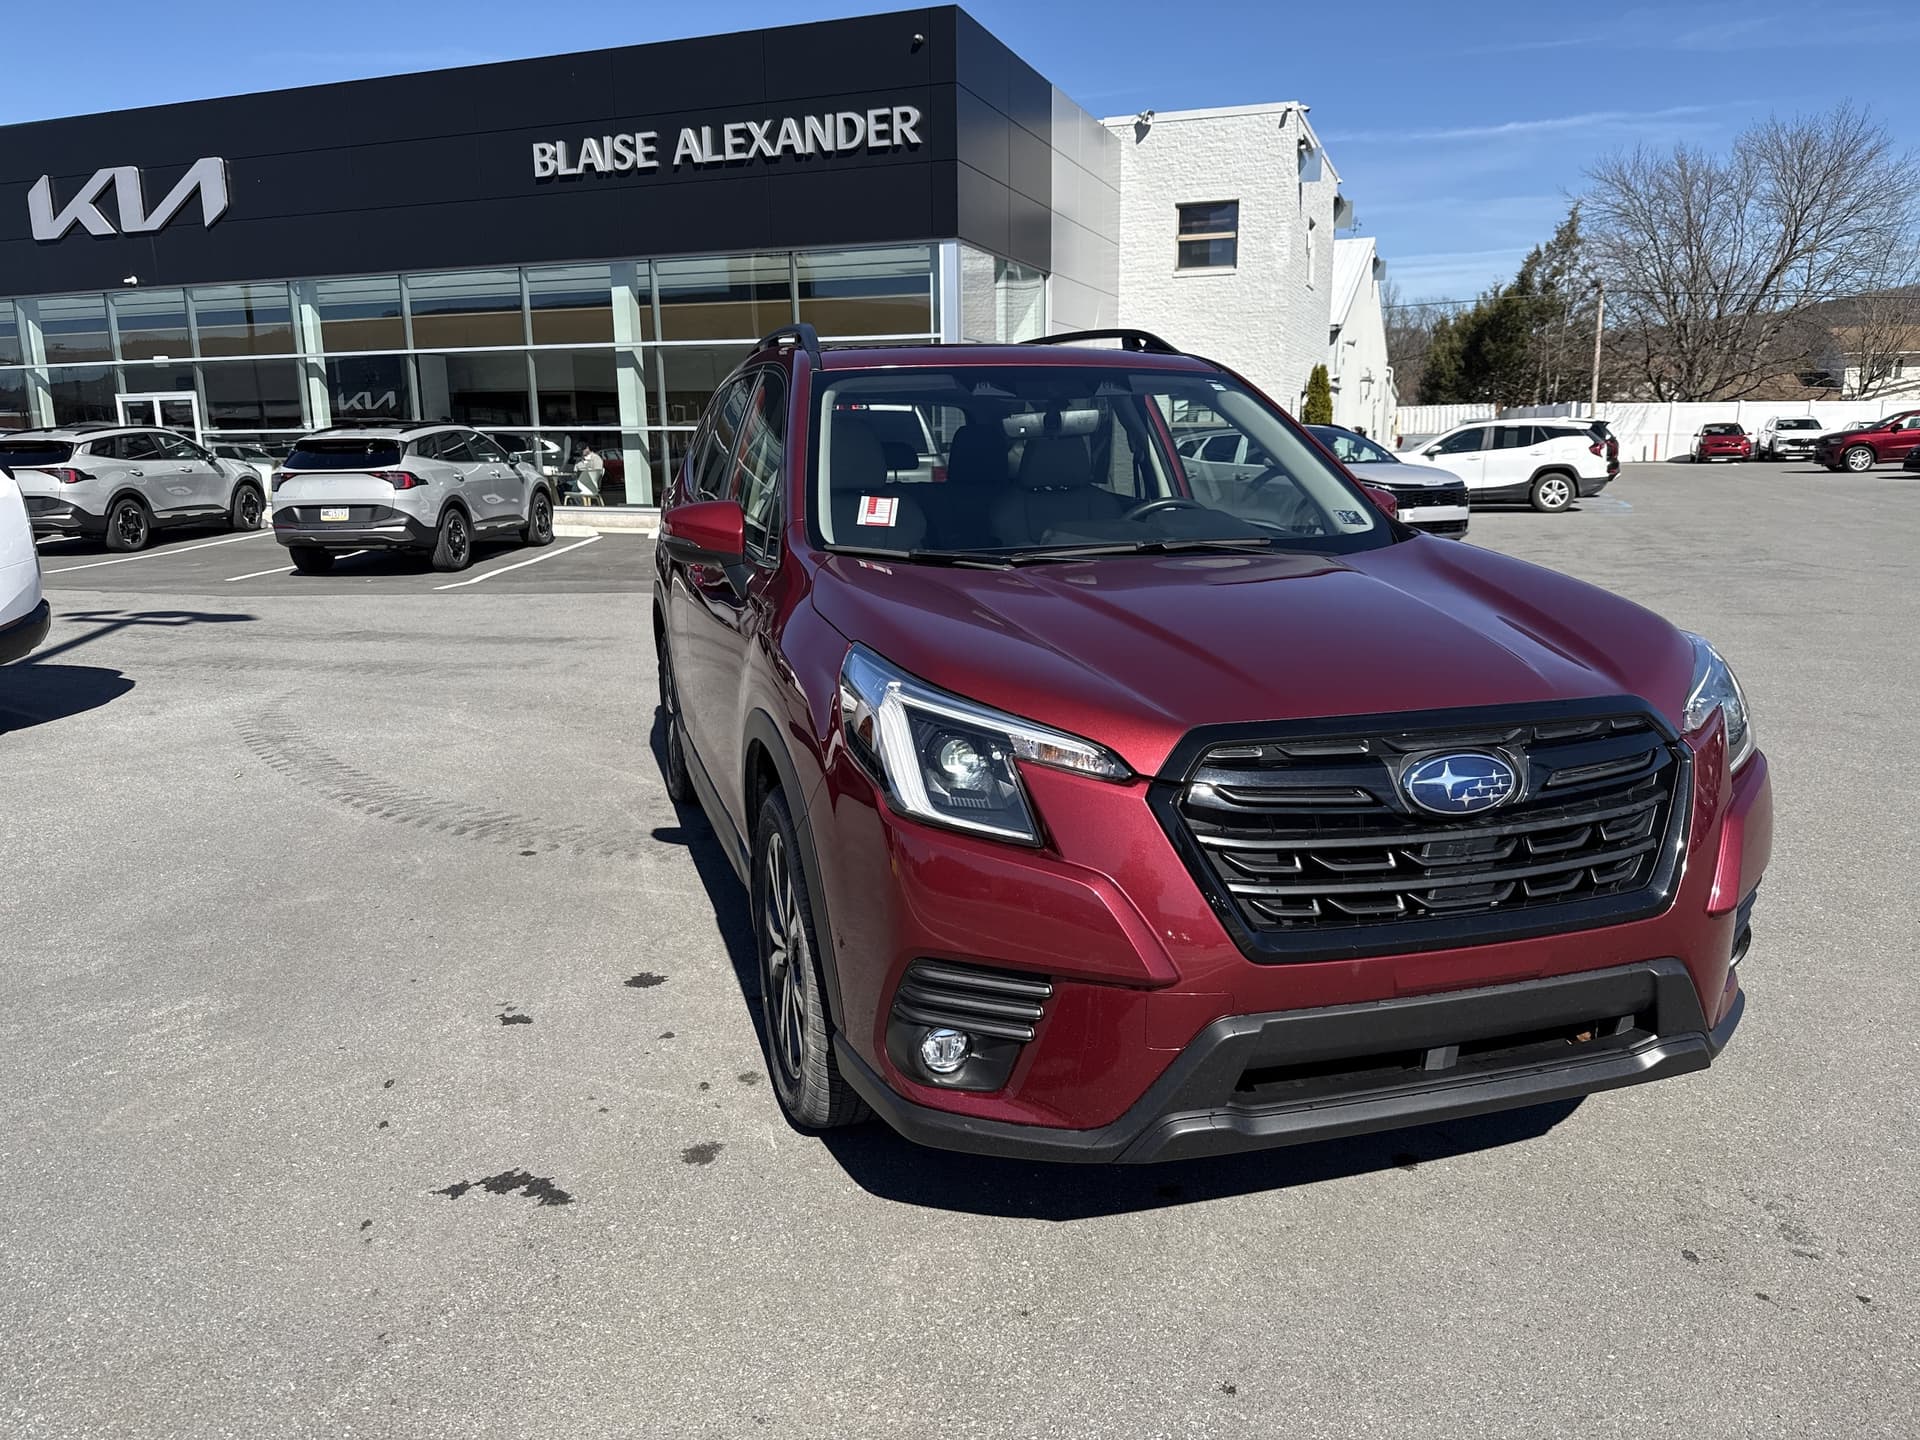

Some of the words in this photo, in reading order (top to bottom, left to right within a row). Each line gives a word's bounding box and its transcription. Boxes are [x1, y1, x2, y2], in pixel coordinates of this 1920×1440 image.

[533, 131, 659, 178] BLAISE
[673, 105, 923, 165] ALEXANDER
[27, 156, 228, 240] KIA
[337, 390, 396, 411] KIA
